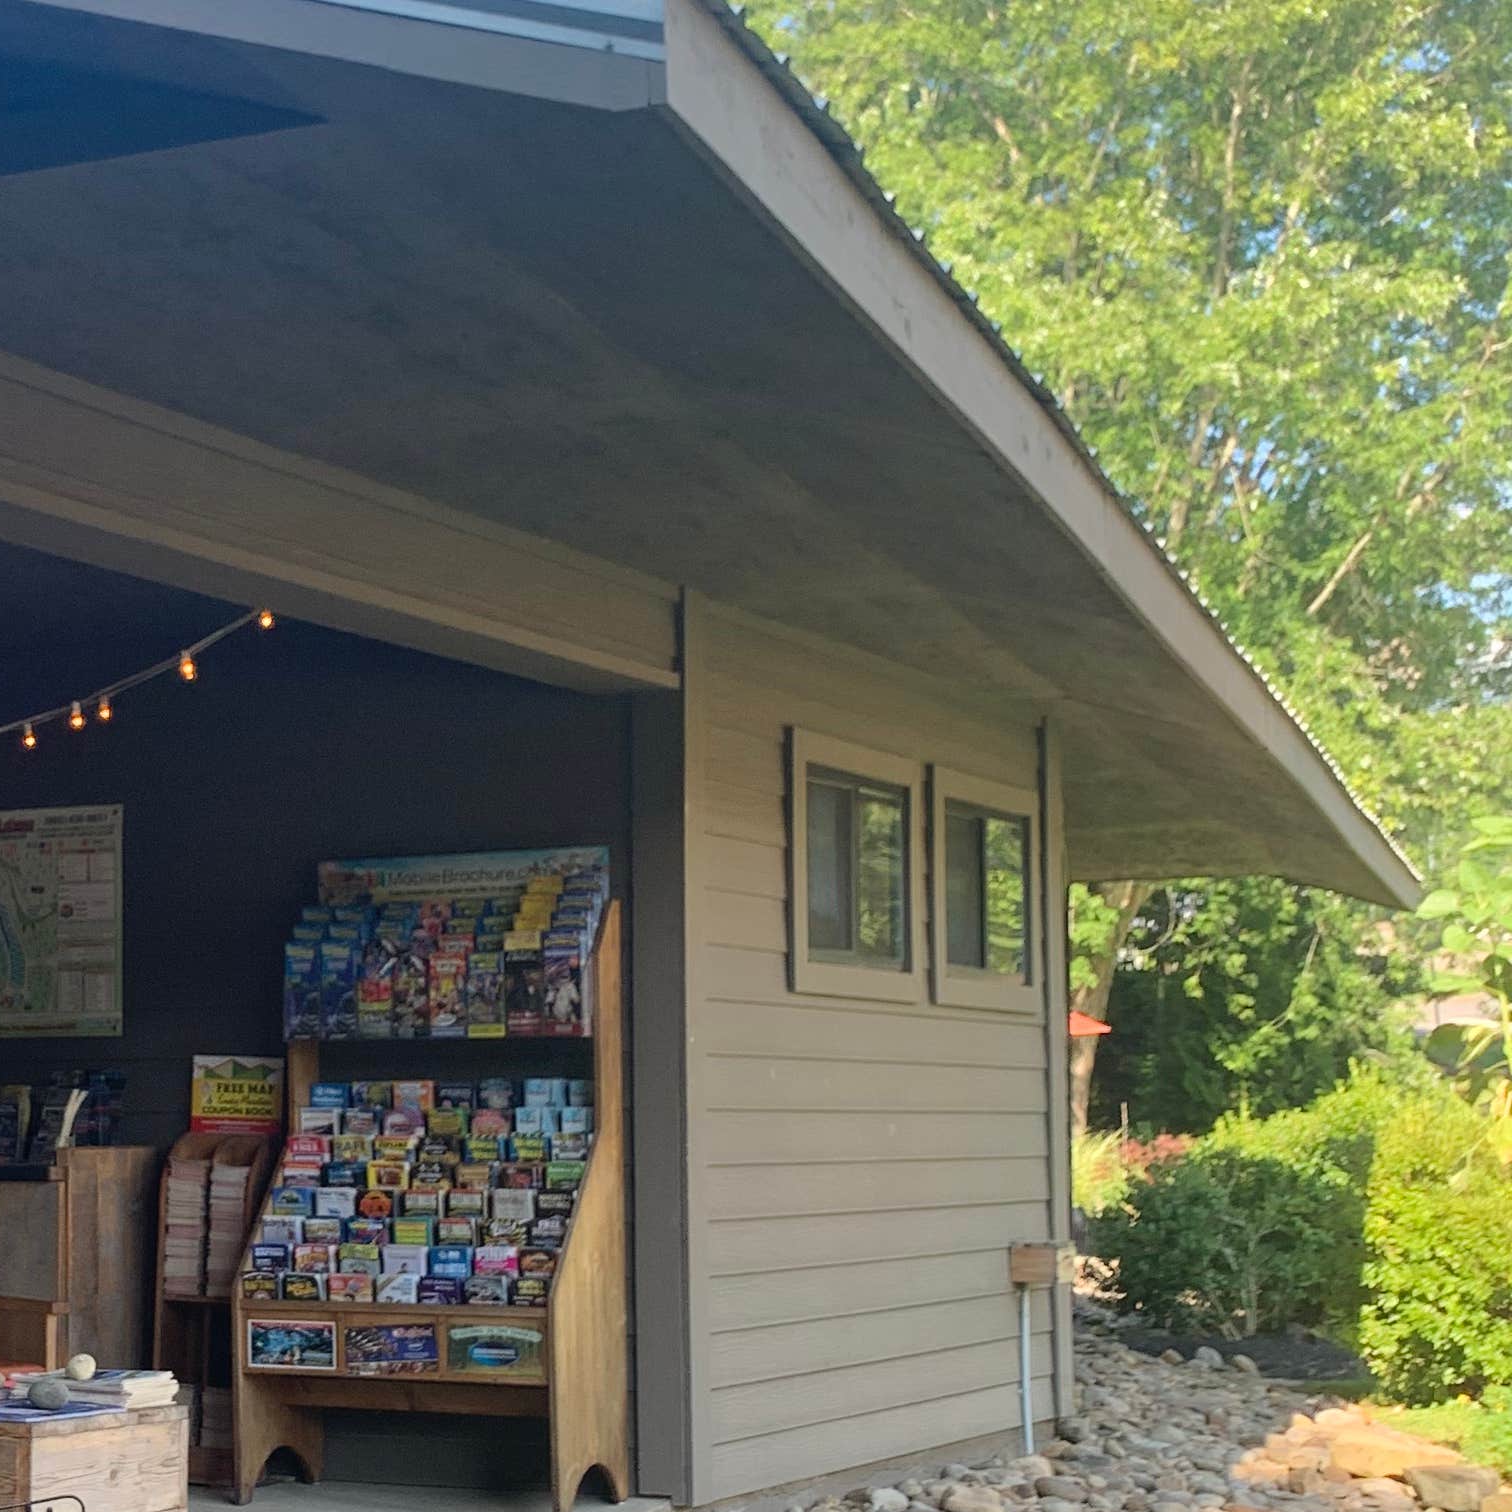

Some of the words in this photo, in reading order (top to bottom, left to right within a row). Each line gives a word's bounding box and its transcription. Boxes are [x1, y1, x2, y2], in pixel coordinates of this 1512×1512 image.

[216, 1083, 245, 1093] FREE
[248, 1083, 274, 1095] MAP
[202, 1106, 244, 1115] COUPON
